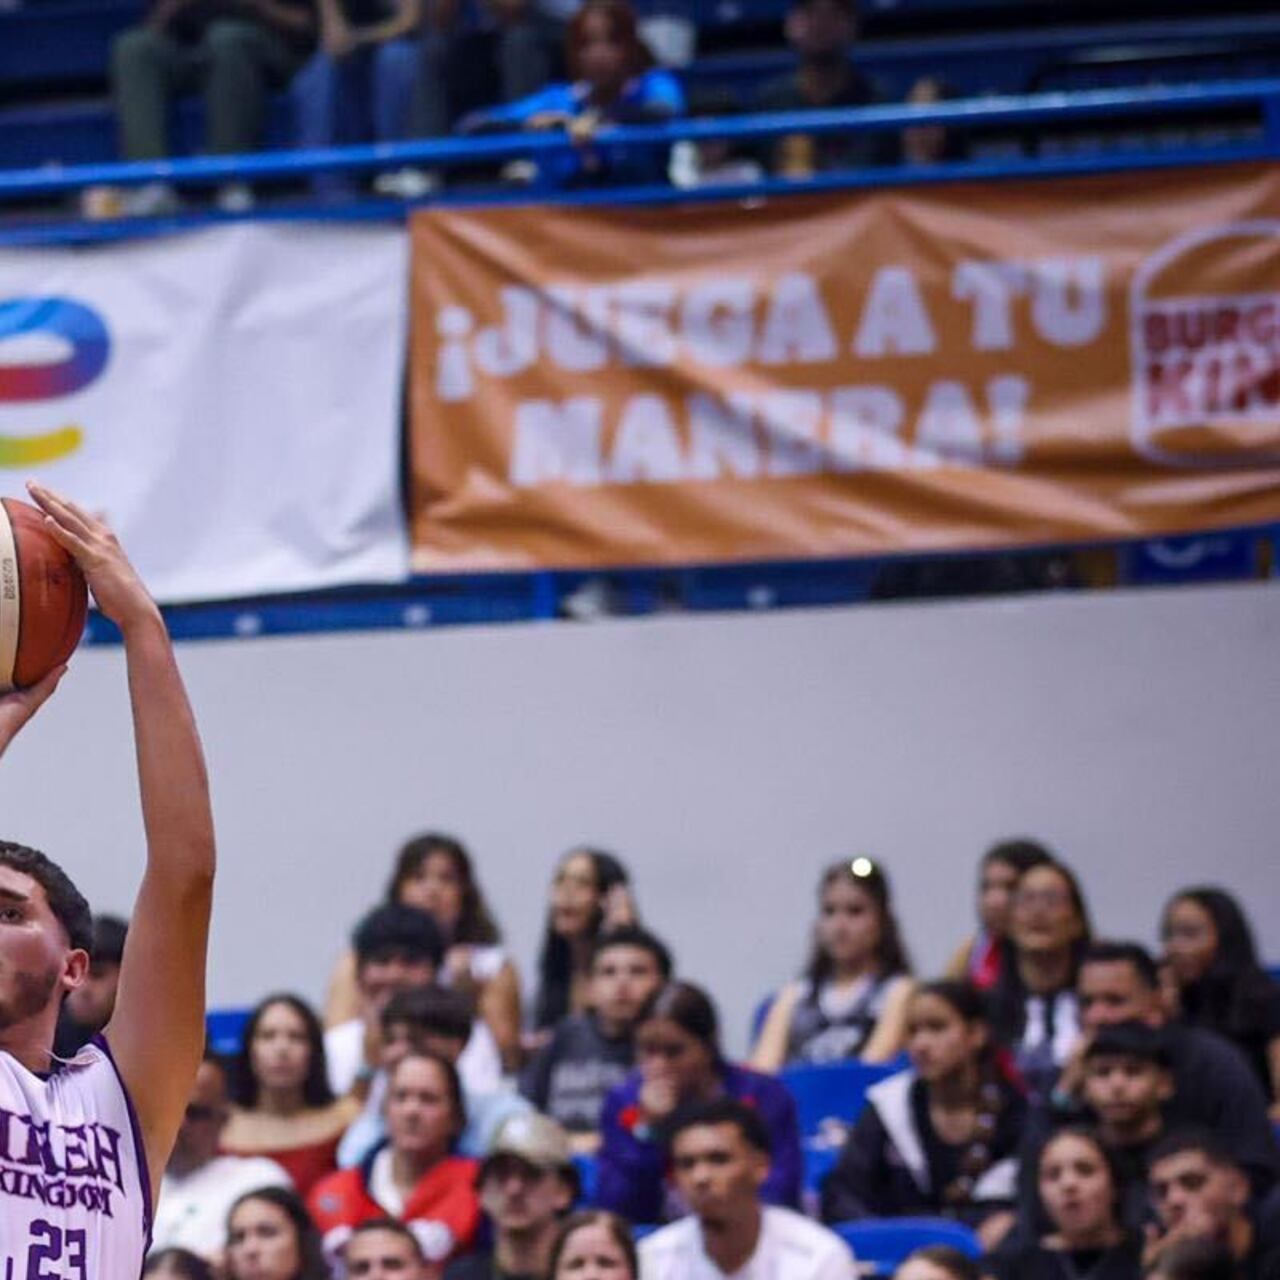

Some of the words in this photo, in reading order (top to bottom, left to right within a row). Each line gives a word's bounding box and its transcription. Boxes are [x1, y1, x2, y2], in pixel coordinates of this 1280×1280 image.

[854, 267, 936, 358] A
[951, 254, 1107, 348] TU
[510, 376, 1029, 487] MANERA!
